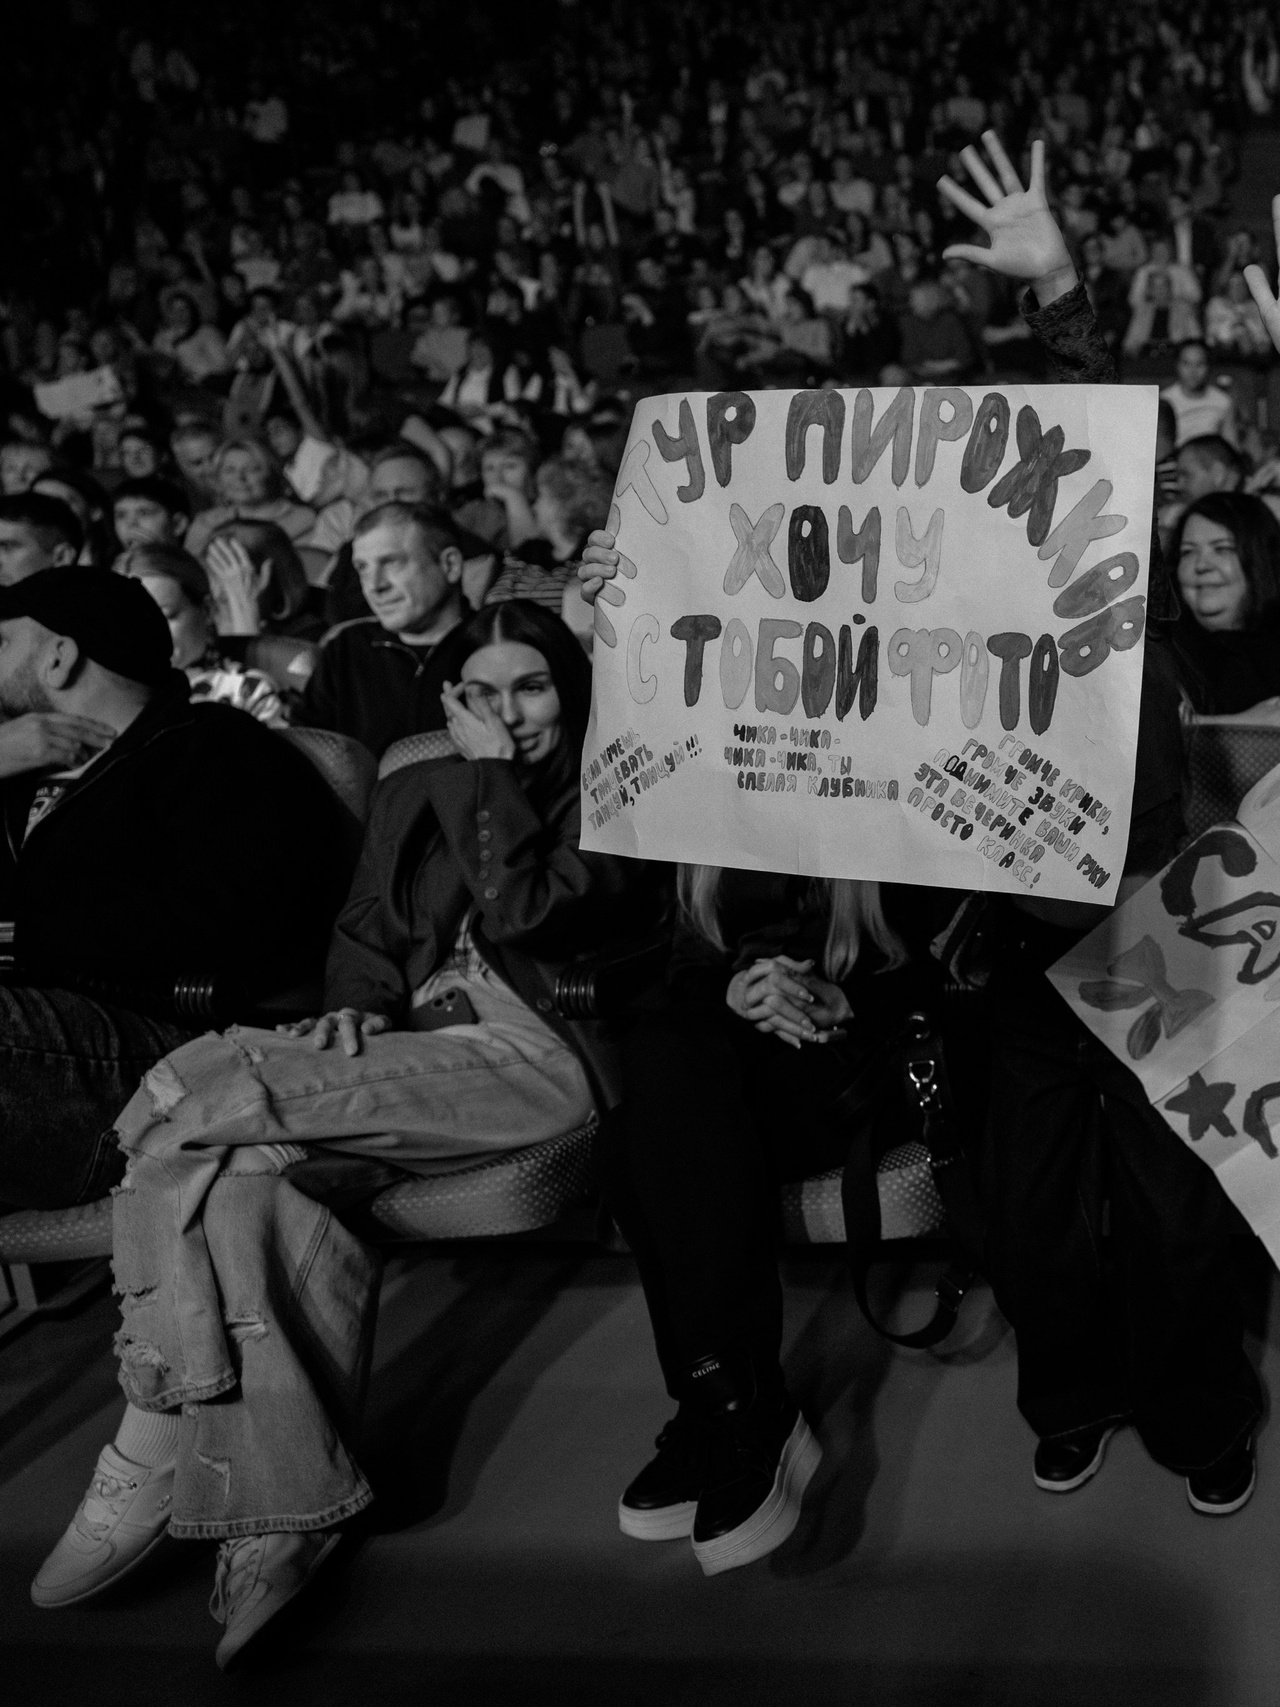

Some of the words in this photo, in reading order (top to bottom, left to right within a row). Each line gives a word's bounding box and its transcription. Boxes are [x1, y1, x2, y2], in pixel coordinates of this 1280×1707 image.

[722, 502, 945, 603] ХОЧУ
[785, 387, 1146, 677] ПИРОЖКОВ
[625, 613, 661, 705] С
[669, 613, 879, 722] ТОБОЙ
[887, 627, 1060, 736] ФОТО
[582, 758, 602, 791] ЕСЛИ
[600, 727, 640, 768] ХОЧЕШЬ
[588, 784, 635, 830] ТАНЦУЙ,
[630, 734, 702, 795] ТАНЦУЙ!!!
[590, 744, 653, 804] ТАНЦЕВАТЬ
[737, 770, 798, 792] СПЕЛАЯ
[808, 776, 900, 801] КЛУБНИКА
[828, 754, 852, 776] ТЫ
[961, 738, 1027, 791] ГРОМЧЕ
[1028, 786, 1086, 835] ЗВУКИ
[998, 733, 1061, 787] ГРОМЧЕ
[1058, 778, 1112, 836] КРИКИ,
[908, 786, 974, 841] ПРОСТО
[976, 835, 1041, 889] КЛАСС!
[914, 762, 950, 797] ЭТА
[951, 788, 1046, 863] ВЕЧЕРИНКА
[933, 748, 1034, 826] ПОДНИМИТЕ
[1035, 818, 1080, 861] ВАШИ
[1076, 853, 1111, 889] РУКИ
[691, 1361, 721, 1379] CELINE
